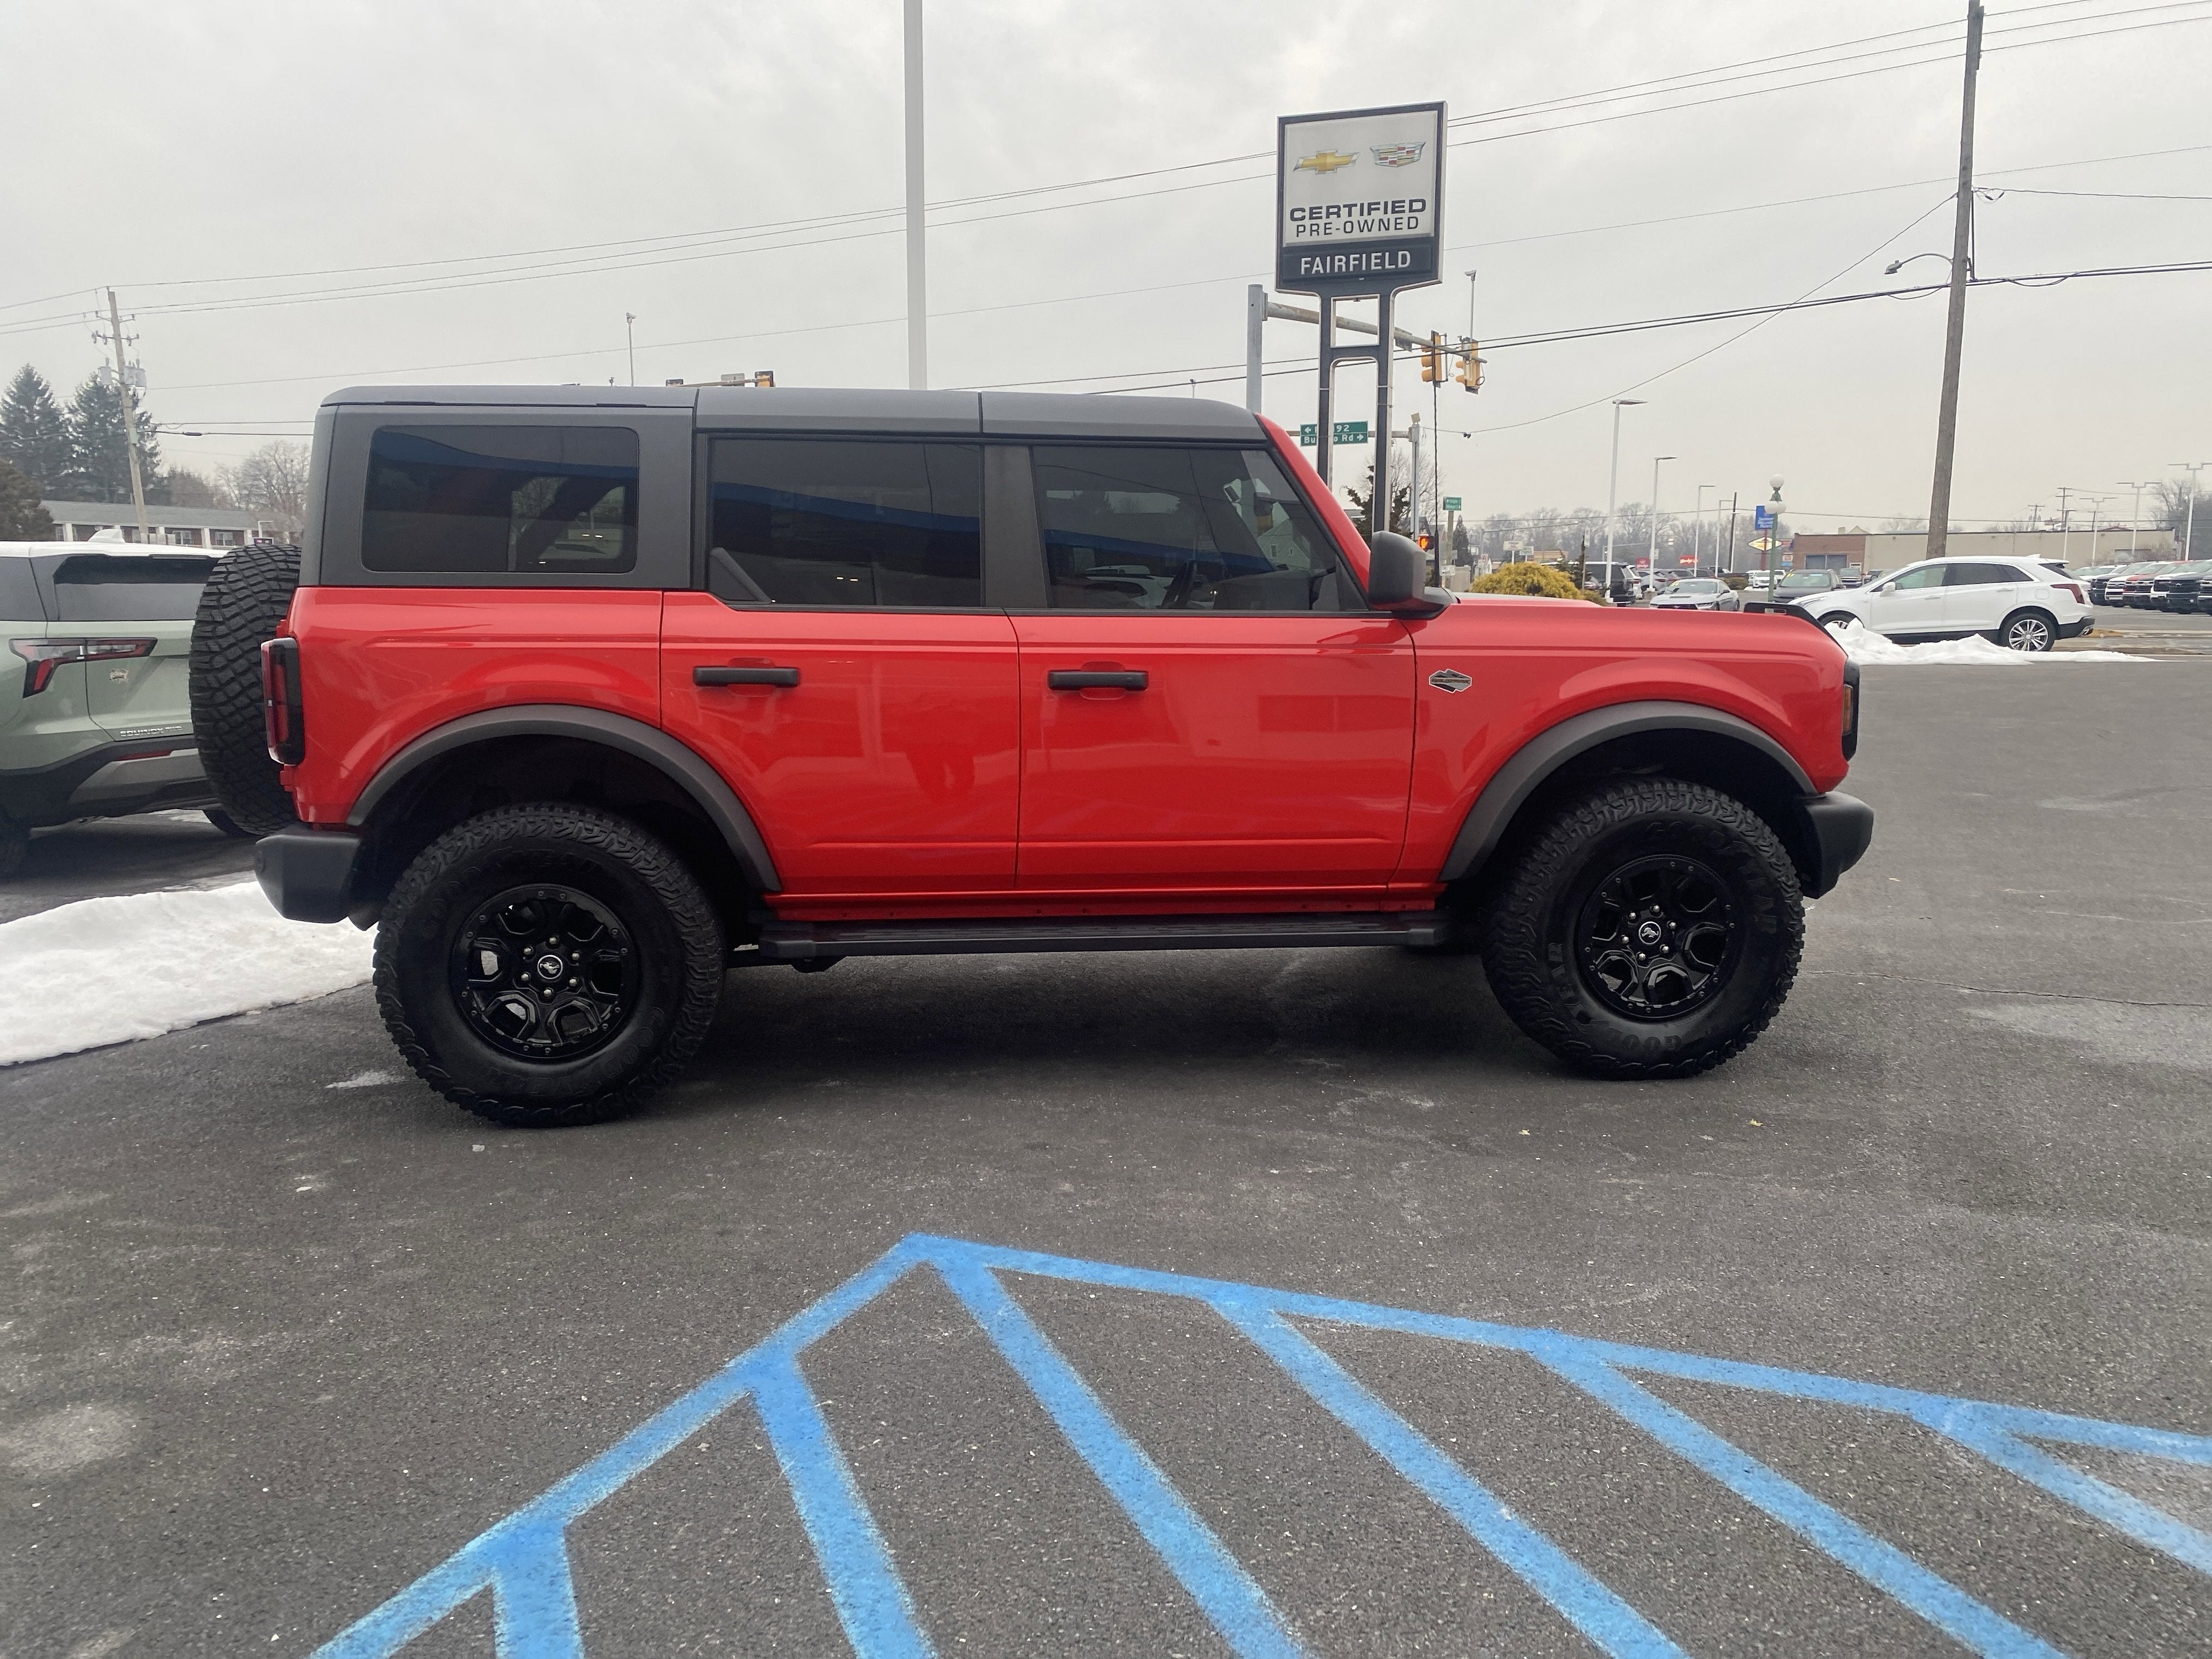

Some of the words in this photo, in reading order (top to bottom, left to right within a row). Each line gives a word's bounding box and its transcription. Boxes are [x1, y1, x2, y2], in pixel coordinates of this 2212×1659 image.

[1290, 198, 1426, 222] CERTIFIED
[1296, 216, 1419, 238] PRE-OWNED
[1300, 250, 1411, 275] FAIRFIELD
[1336, 424, 1350, 433] 92
